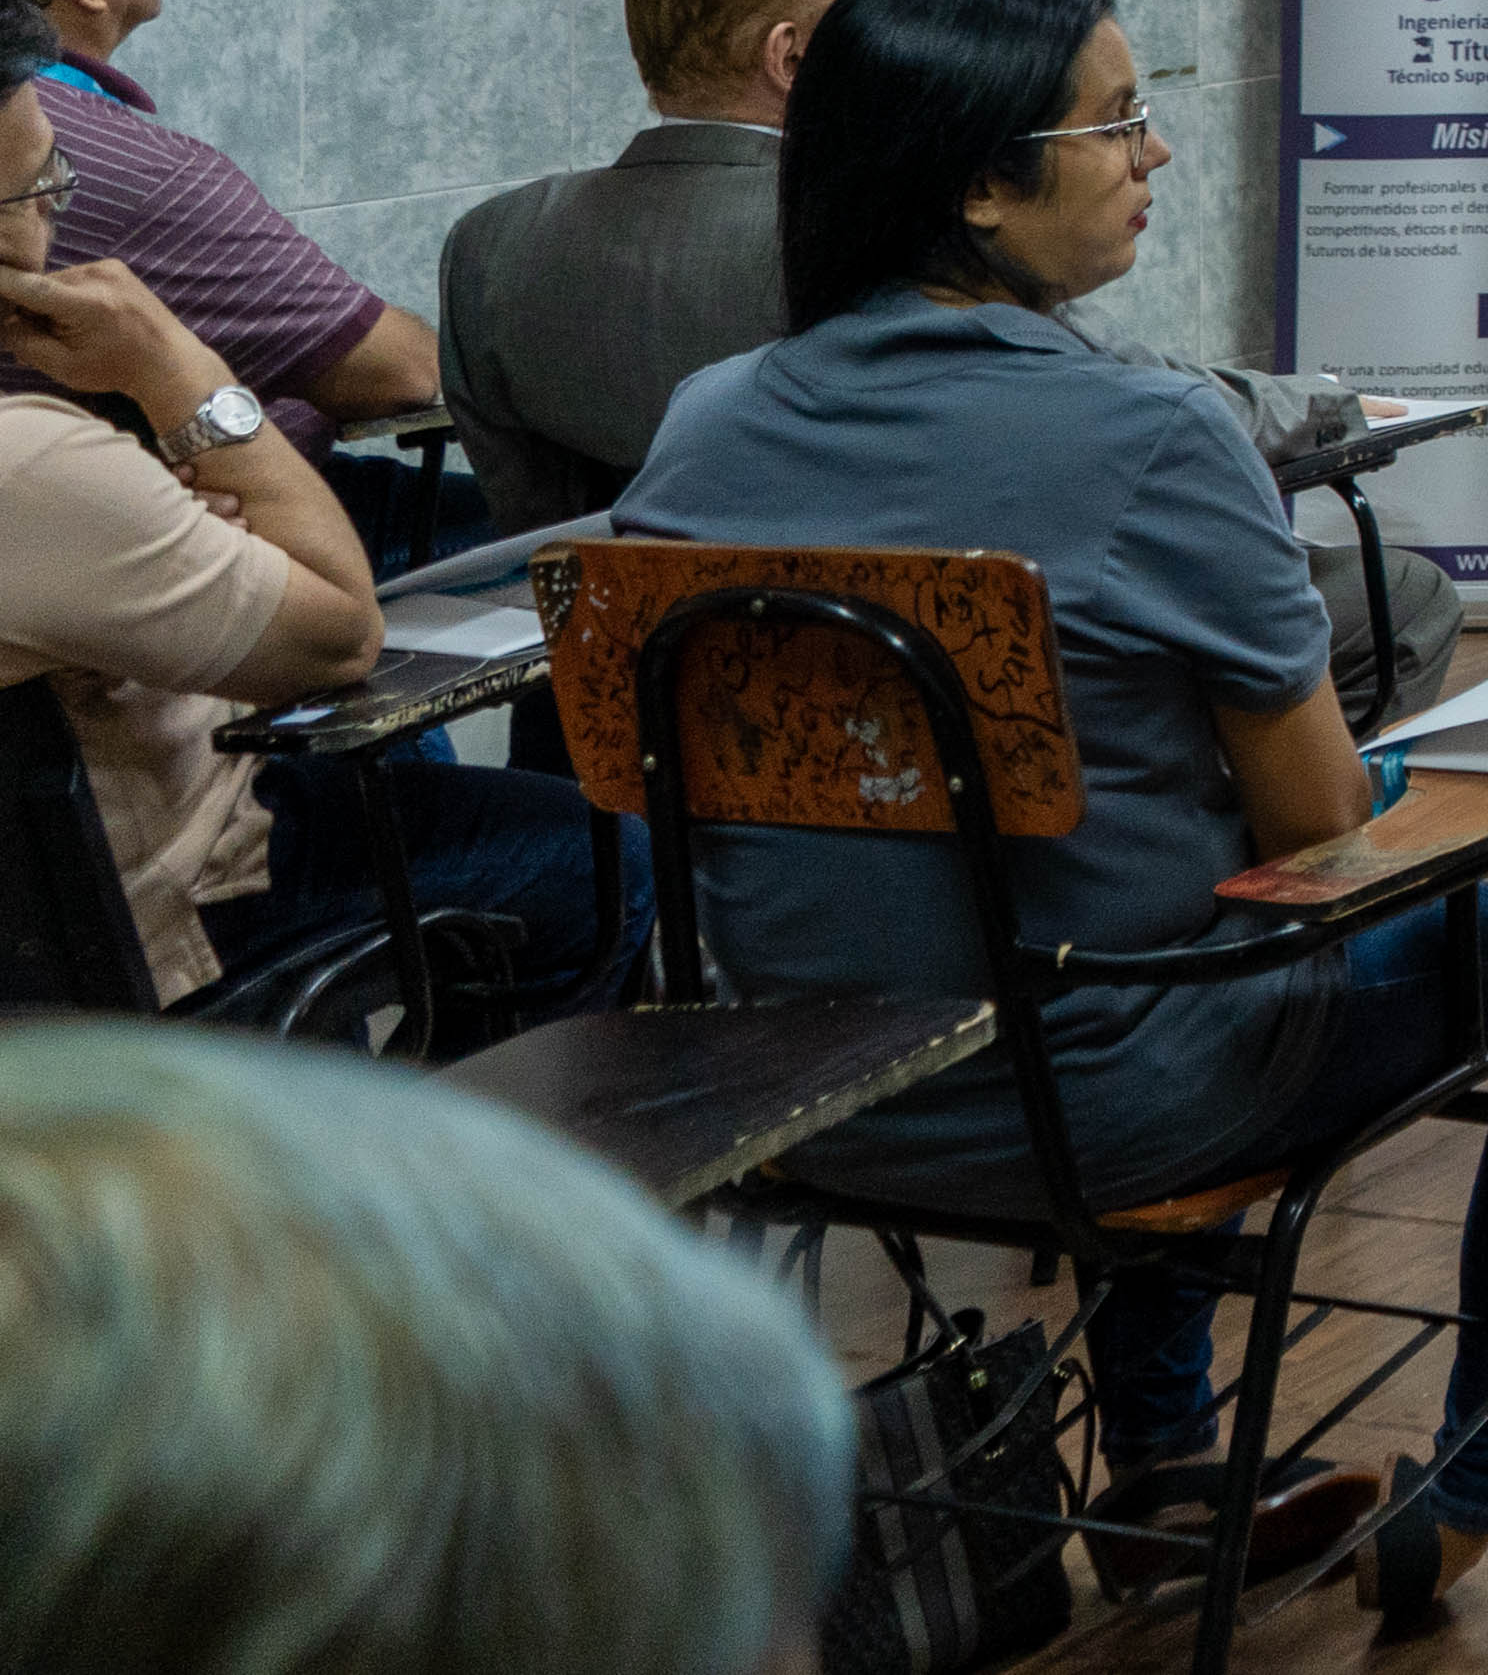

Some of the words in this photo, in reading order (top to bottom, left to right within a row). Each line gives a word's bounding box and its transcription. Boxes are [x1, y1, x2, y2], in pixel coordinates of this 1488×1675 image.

[1386, 67, 1450, 85] Técnico
[1323, 181, 1376, 196] Formar
[1380, 180, 1477, 197] profesionales
[1305, 202, 1419, 218] comprometidos
[1421, 203, 1448, 216] con
[1451, 201, 1465, 215] el
[1403, 223, 1447, 237] éticos
[1449, 226, 1460, 237] e
[1304, 243, 1356, 259] futuros
[1359, 244, 1377, 258] de
[1378, 243, 1392, 258] la
[1393, 243, 1462, 258] sociedad.
[1347, 365, 1375, 377] una
[1378, 361, 1461, 376] comunidad
